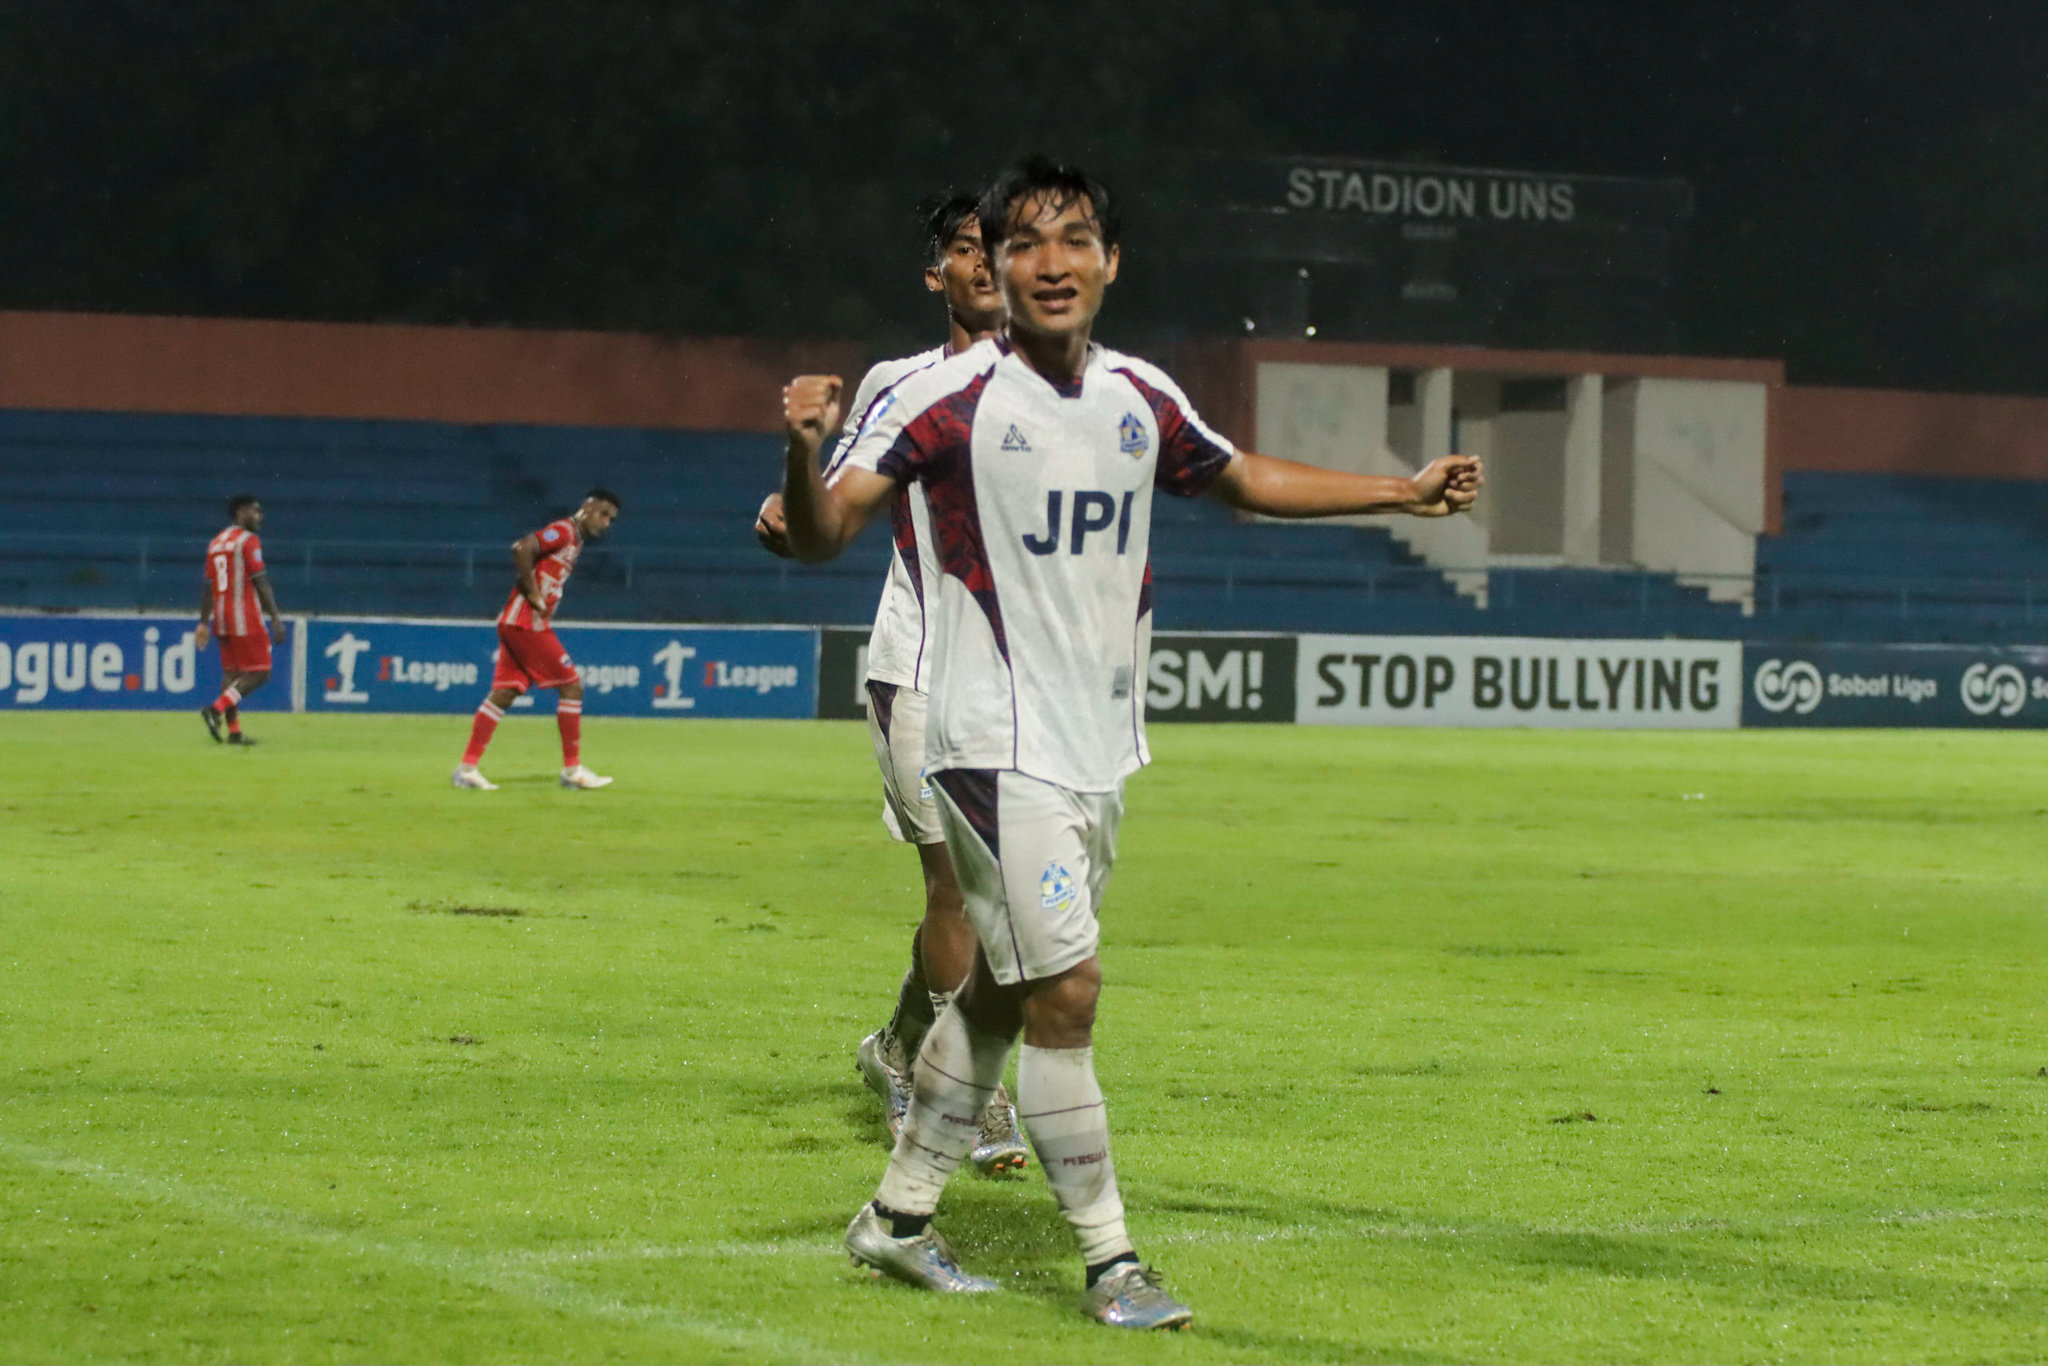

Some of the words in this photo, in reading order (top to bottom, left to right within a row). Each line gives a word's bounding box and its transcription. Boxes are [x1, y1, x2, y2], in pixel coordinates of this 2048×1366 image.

[1288, 168, 1475, 217] STADION
[1489, 180, 1575, 221] UNS
[1022, 489, 1135, 556] JPI
[1146, 649, 1265, 711] SM!
[1316, 653, 1455, 709] STOP
[1472, 655, 1719, 712] BULLYING
[1828, 673, 1889, 697] Sobat
[1893, 674, 1937, 703] Liga
